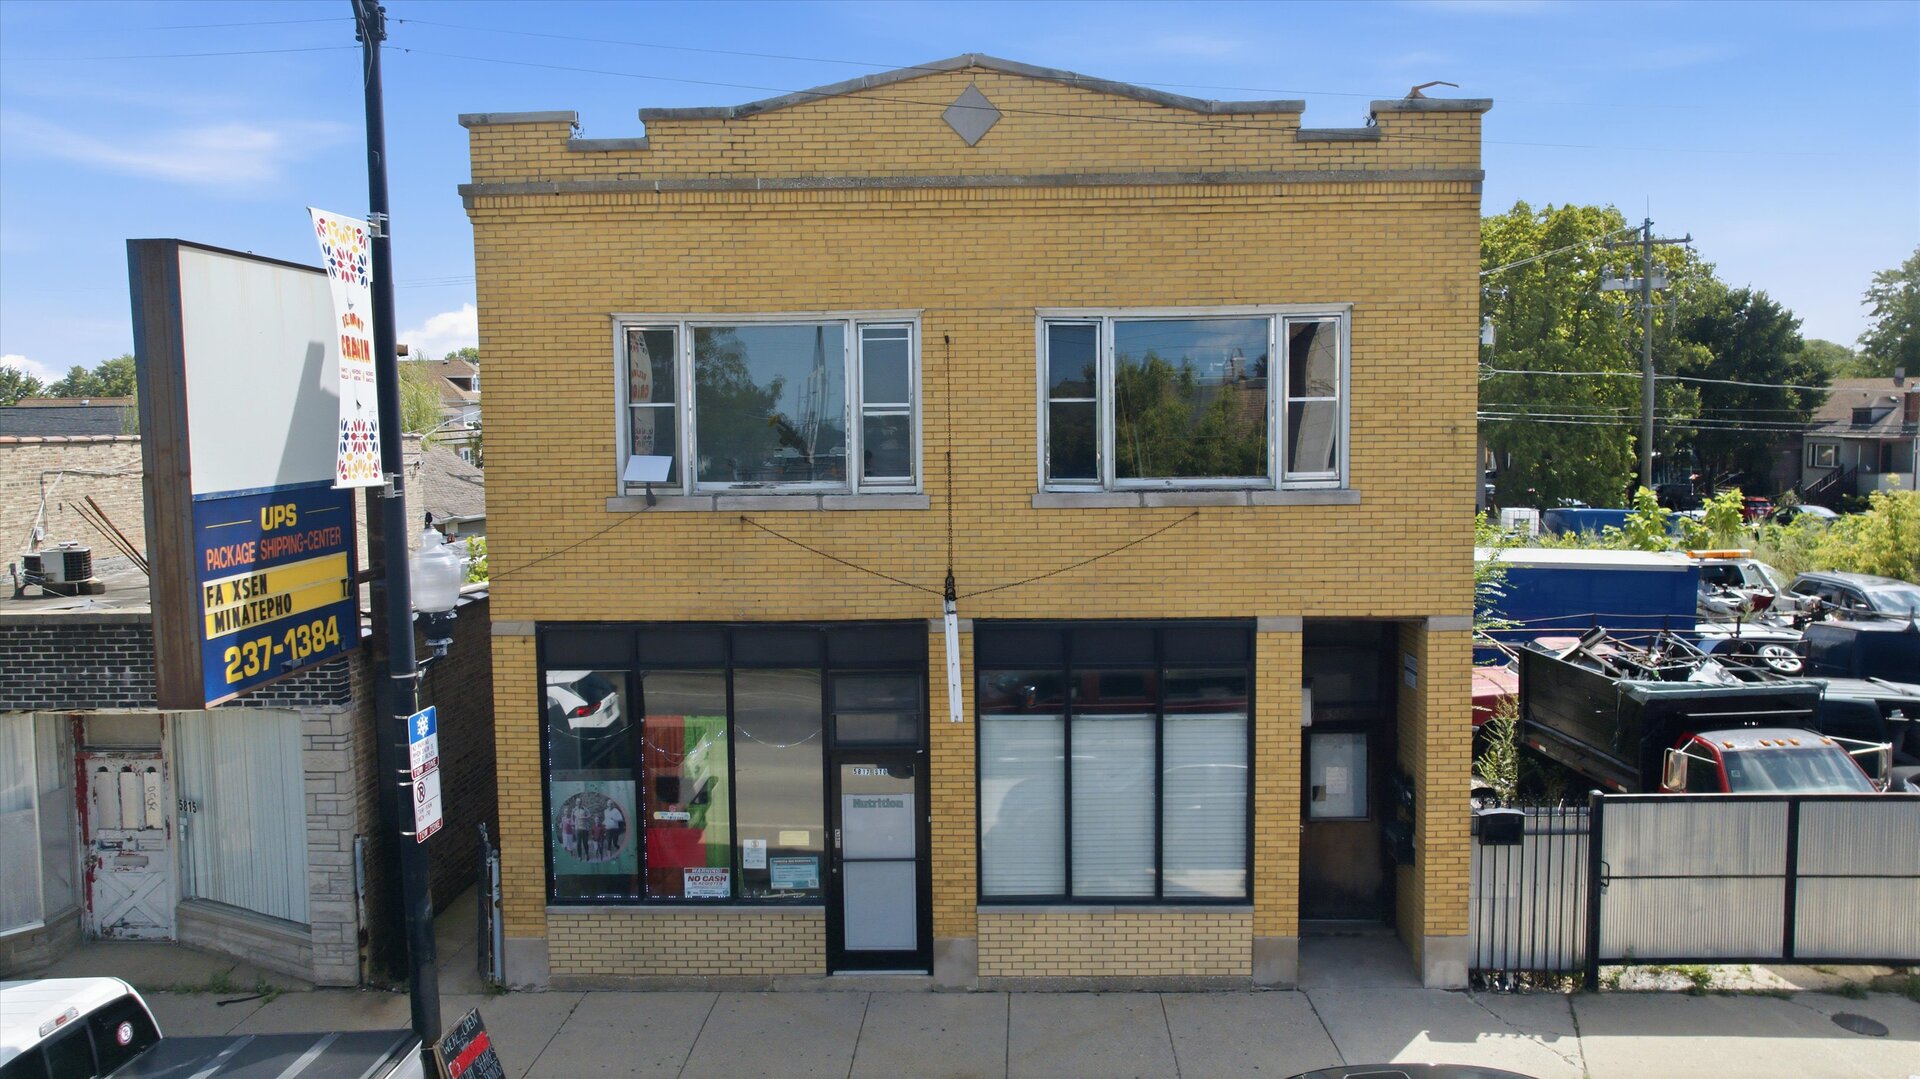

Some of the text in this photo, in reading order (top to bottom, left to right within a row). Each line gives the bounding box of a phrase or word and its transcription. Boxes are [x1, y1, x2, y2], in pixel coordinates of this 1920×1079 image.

[261, 503, 297, 531] UPS
[206, 527, 342, 571] PACKAGE SHIPPING-CENTER
[207, 573, 268, 608] FA XSEN
[215, 593, 292, 634] MINATEPHO
[224, 615, 340, 684] 237-1384
[179, 799, 197, 814] 5815
[853, 798, 904, 808] Nutrition
